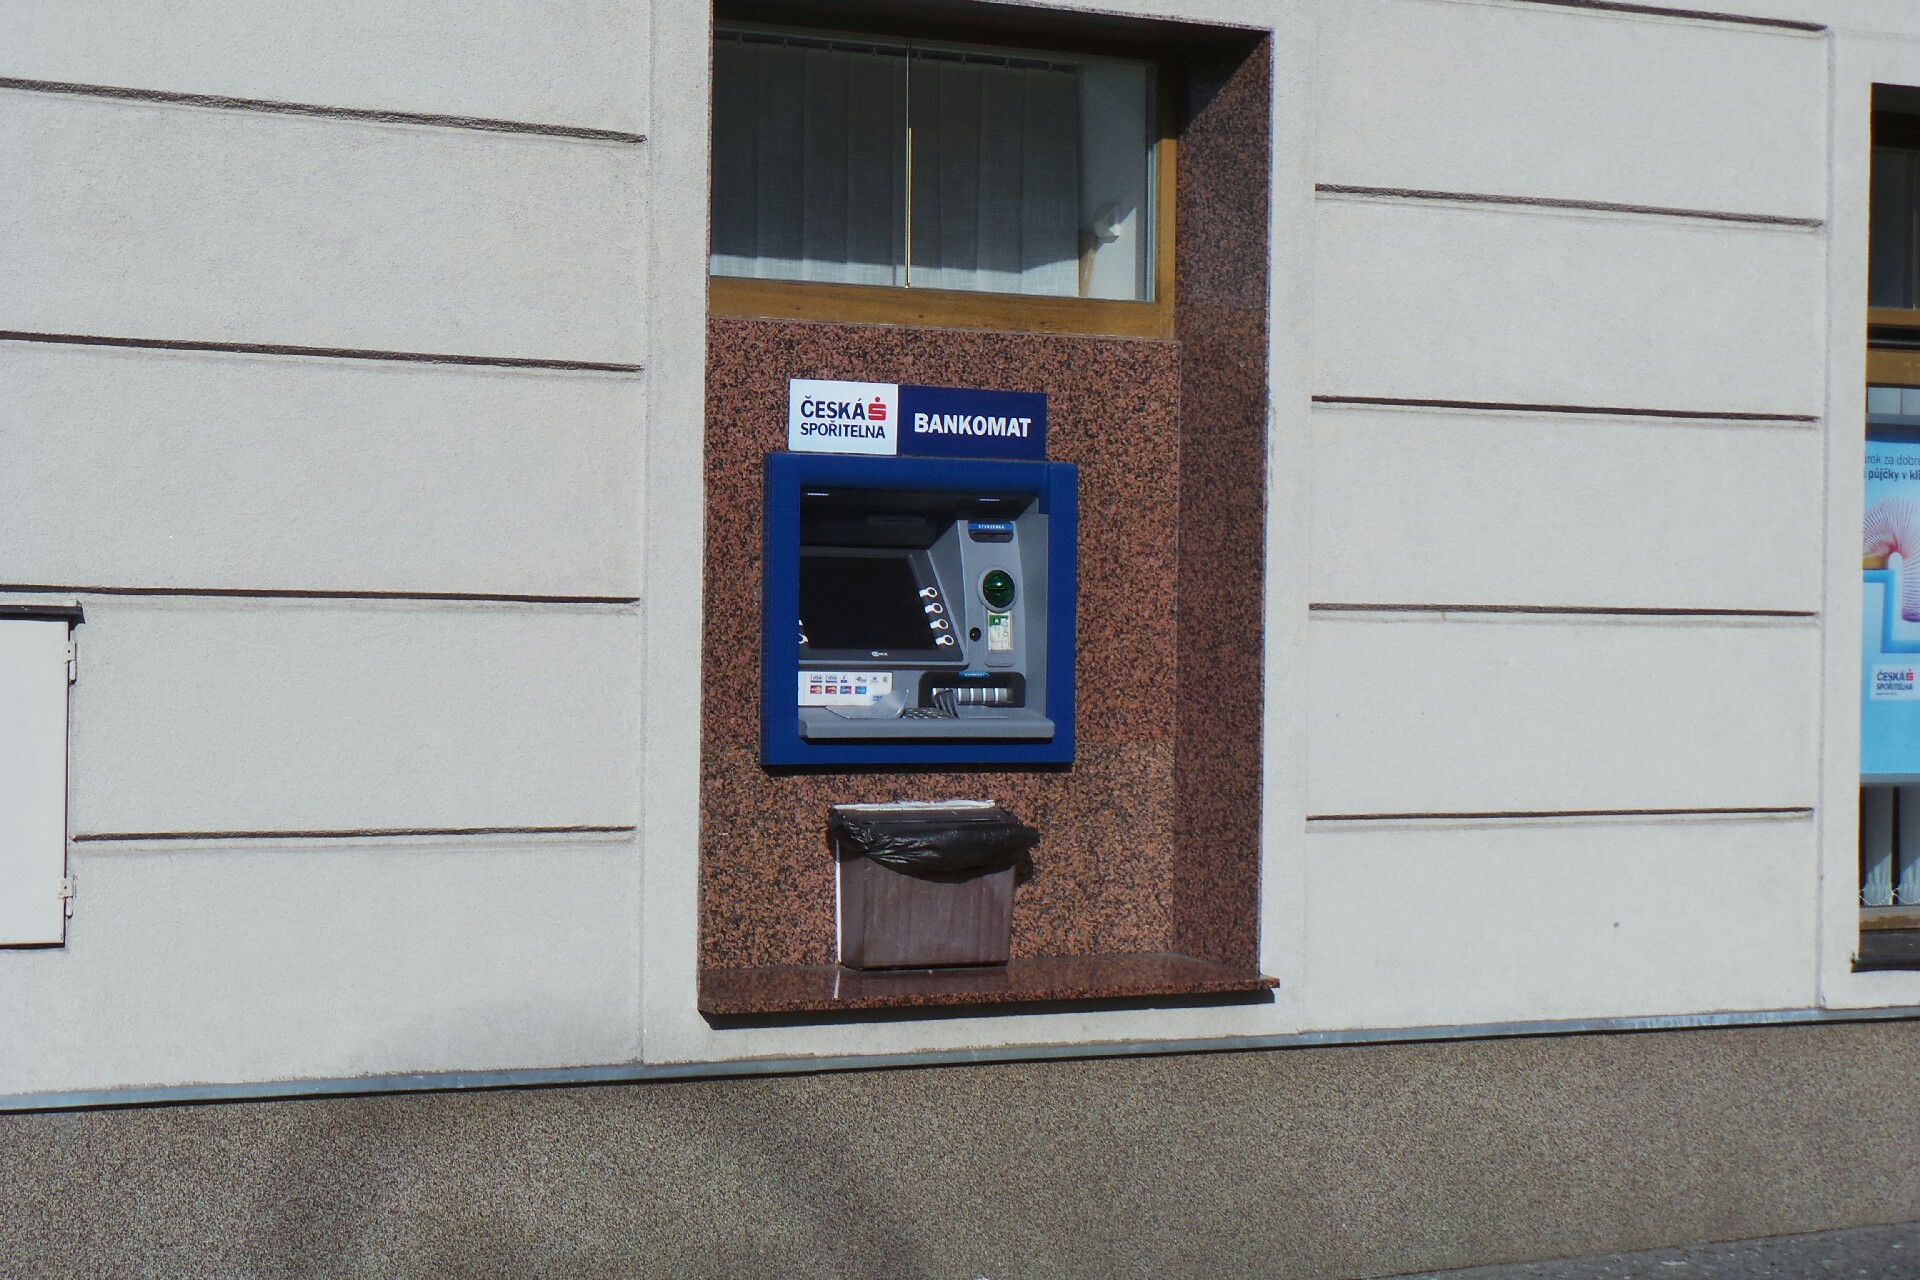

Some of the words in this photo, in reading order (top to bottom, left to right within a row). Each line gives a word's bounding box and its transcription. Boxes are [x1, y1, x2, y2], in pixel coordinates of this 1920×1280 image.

[801, 396, 865, 420] ČESKÁ
[800, 420, 886, 438] SPOŘITELNA
[914, 413, 1031, 438] BANKOMAT
[1884, 456, 1894, 465] za
